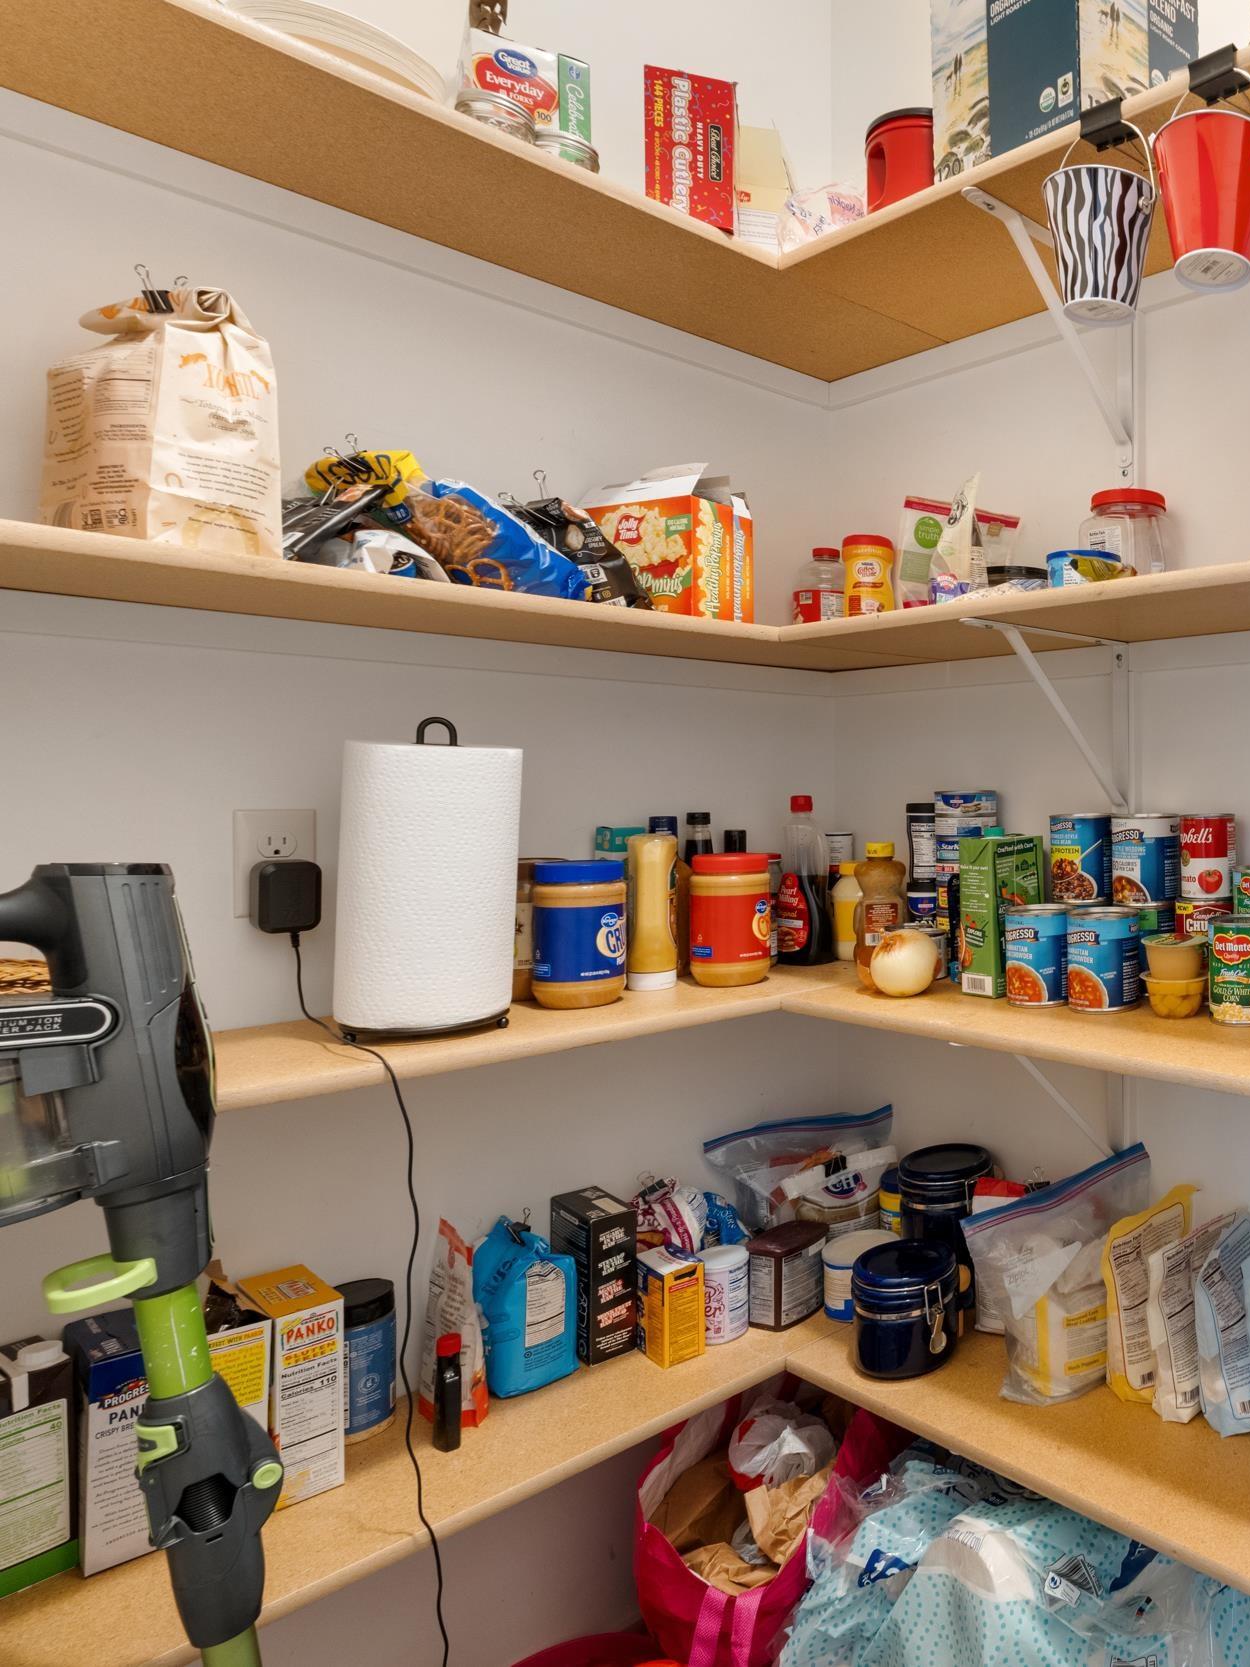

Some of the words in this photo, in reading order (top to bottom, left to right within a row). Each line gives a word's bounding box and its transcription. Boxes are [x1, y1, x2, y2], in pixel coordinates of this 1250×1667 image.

[485, 70, 544, 100] Everyday
[654, 79, 663, 96] 144
[536, 111, 552, 122] 100
[654, 97, 664, 127] PIECES
[672, 77, 692, 144] Plastic
[696, 122, 704, 151] HEAVY
[670, 145, 692, 214] Cutlery
[619, 518, 638, 530] Jolly
[918, 525, 939, 534] simple
[619, 529, 638, 540] Time
[918, 532, 939, 540] truth
[1186, 919, 1208, 932] CHU
[1216, 942, 1225, 950] Del
[1226, 942, 1250, 951] Monte
[1213, 985, 1227, 993] GOLD
[26, 1024, 60, 1032] PACK
[286, 1317, 335, 1343] PANKO
[285, 1341, 336, 1360] GLUTEN
[281, 1365, 315, 1379] Nutrition
[317, 1358, 337, 1368] Facts
[104, 1383, 150, 1409] PROGRES
[281, 1386, 314, 1400] Calories
[320, 1375, 337, 1386] 110
[109, 1405, 145, 1425] PAN
[95, 1427, 120, 1440] CRISPY
